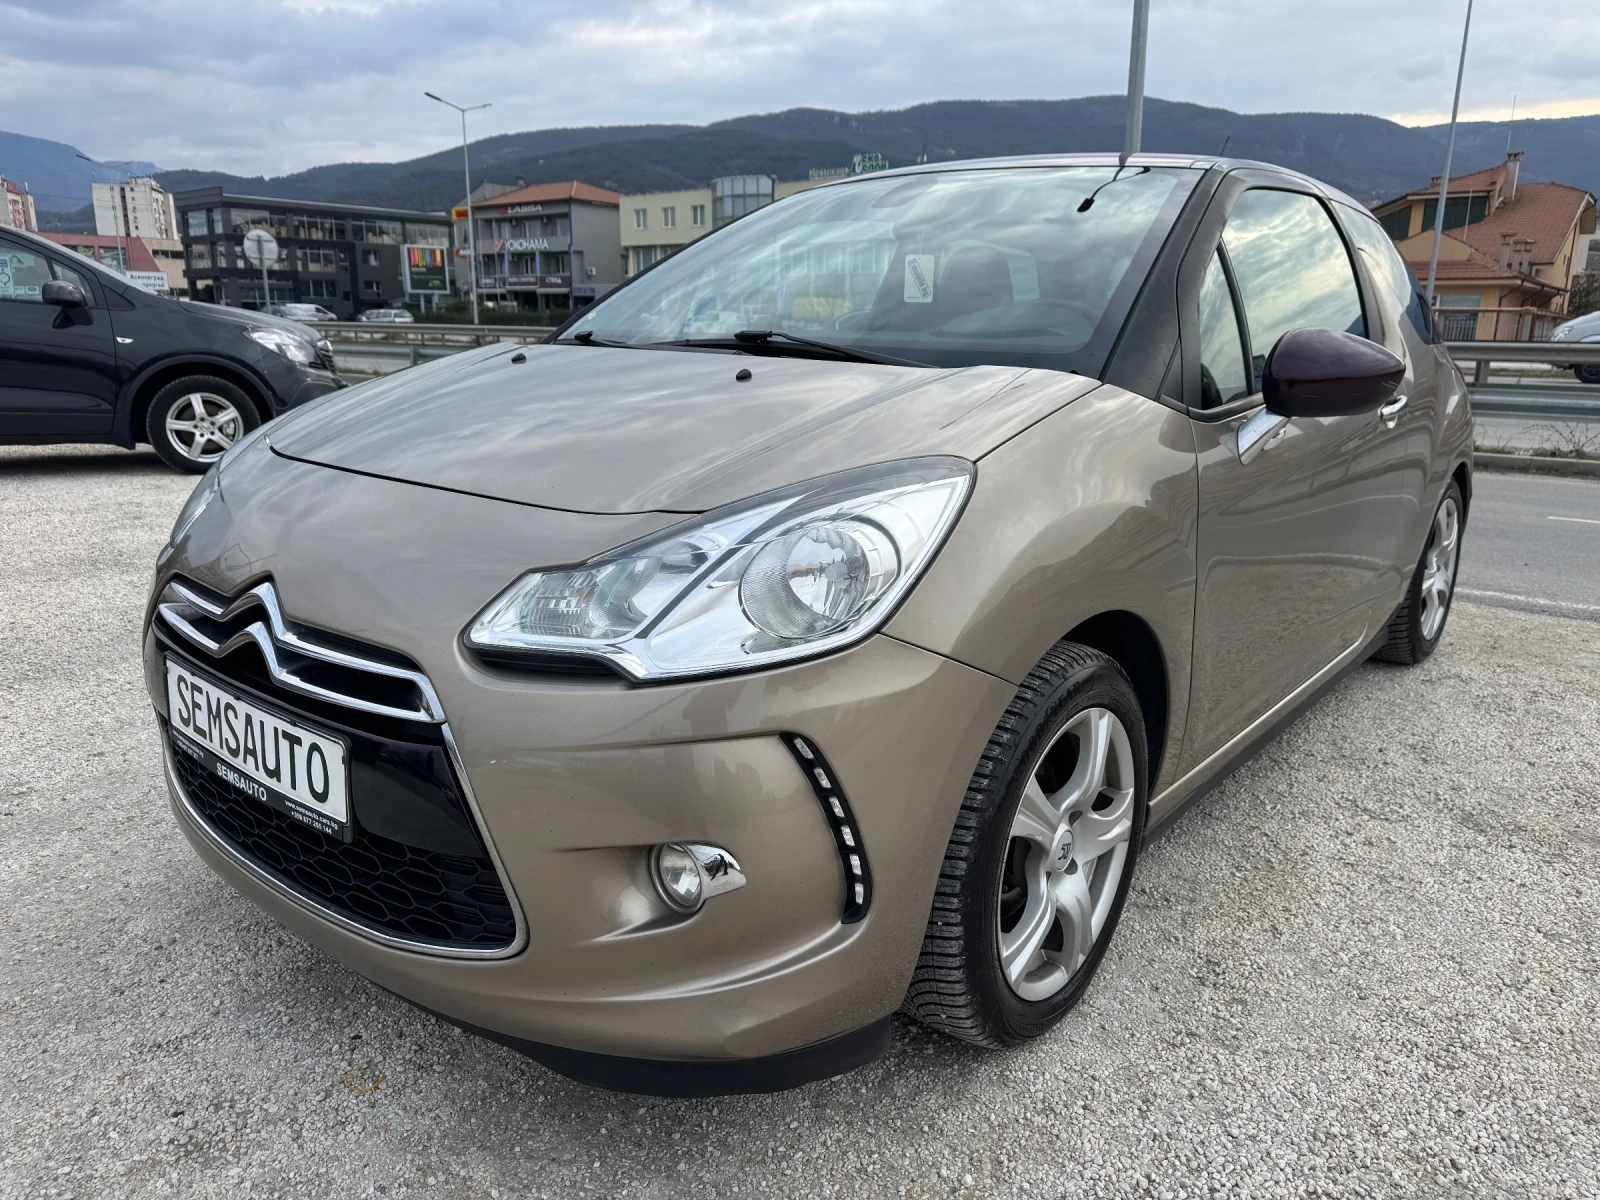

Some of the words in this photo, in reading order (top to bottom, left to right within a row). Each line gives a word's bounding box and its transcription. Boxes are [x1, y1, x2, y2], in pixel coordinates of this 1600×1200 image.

[507, 204, 542, 214] LASSA
[504, 238, 549, 251] YOKOHAMA
[911, 265, 930, 297] mobile.bg
[177, 674, 329, 803] SEMSAUTO
[216, 762, 267, 801] SEMSAUTO
